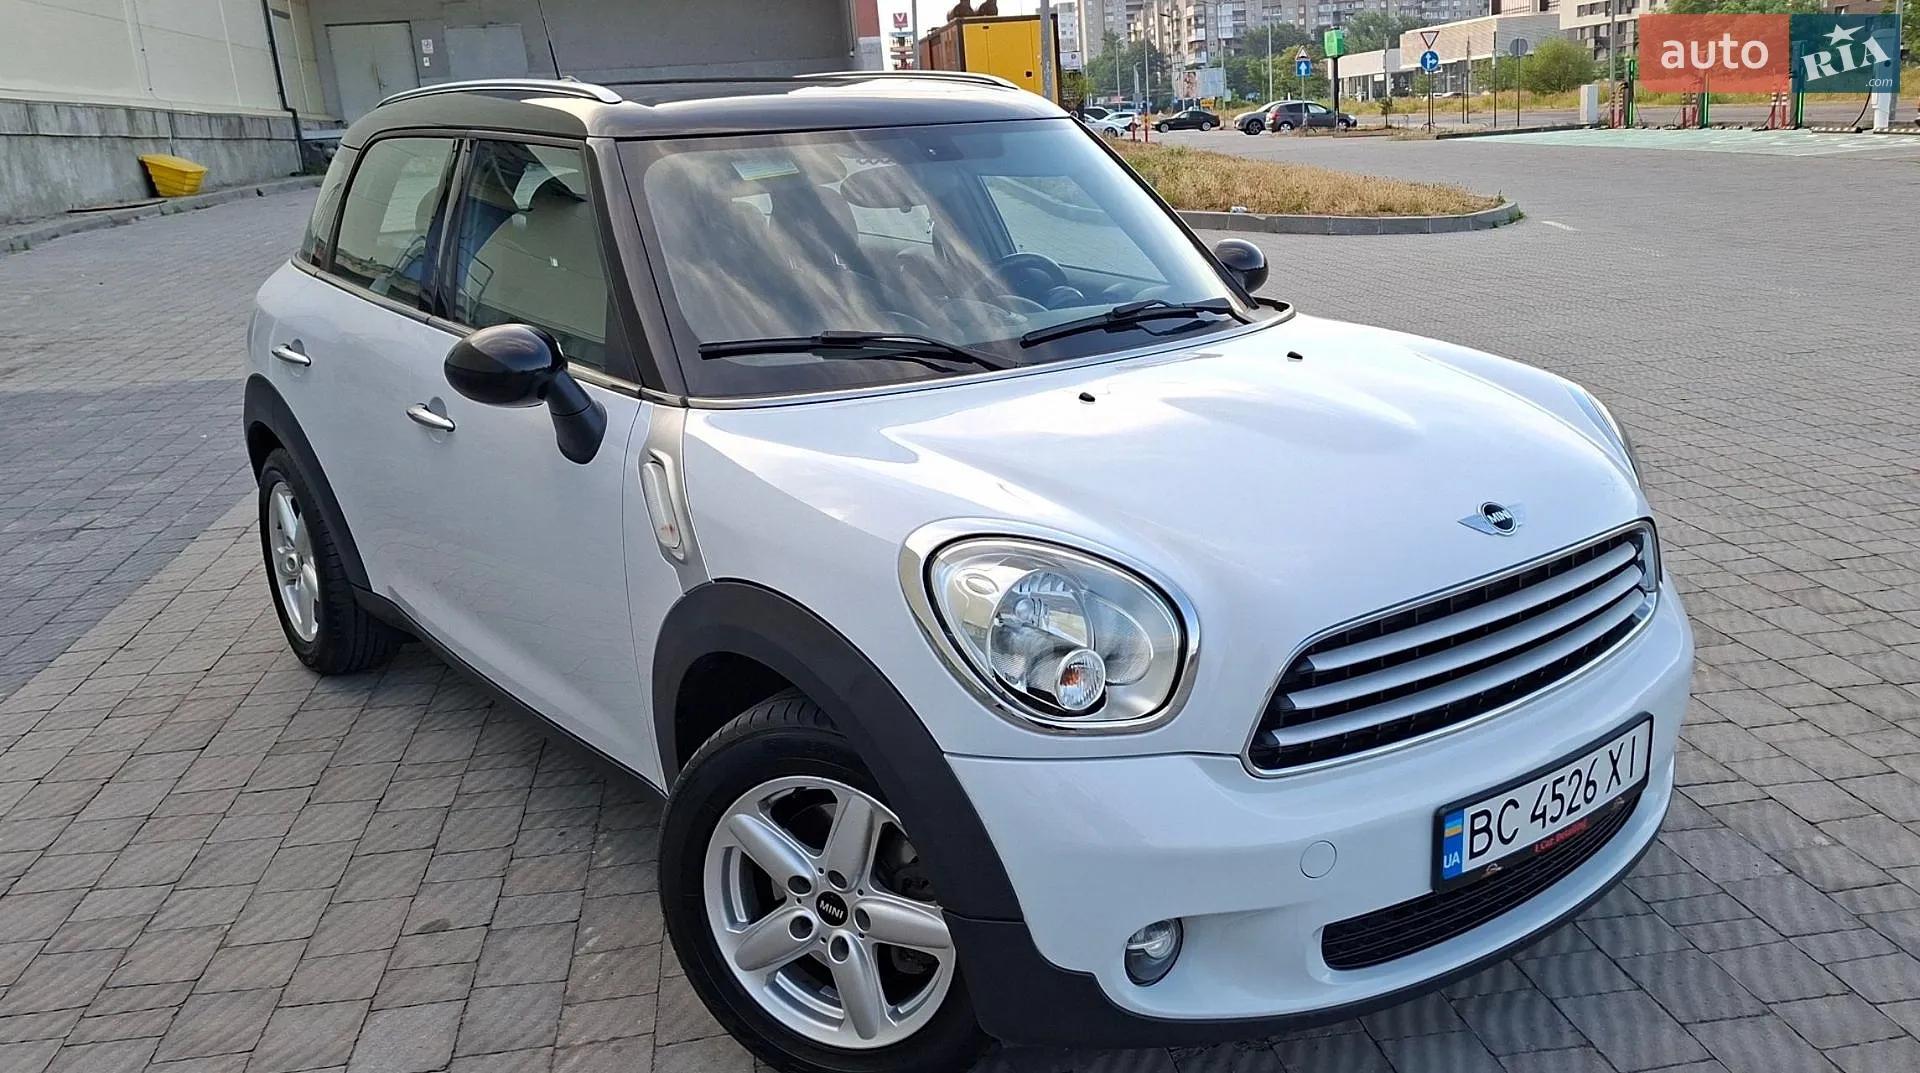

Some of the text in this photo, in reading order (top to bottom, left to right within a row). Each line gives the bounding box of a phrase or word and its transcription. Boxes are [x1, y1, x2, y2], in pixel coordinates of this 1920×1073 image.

[1486, 509, 1513, 524] MINI
[1469, 799, 1520, 860] BC
[1530, 758, 1598, 829] 4526
[1605, 736, 1636, 793] XI
[1443, 851, 1461, 869] UA
[820, 900, 844, 919] MINI
